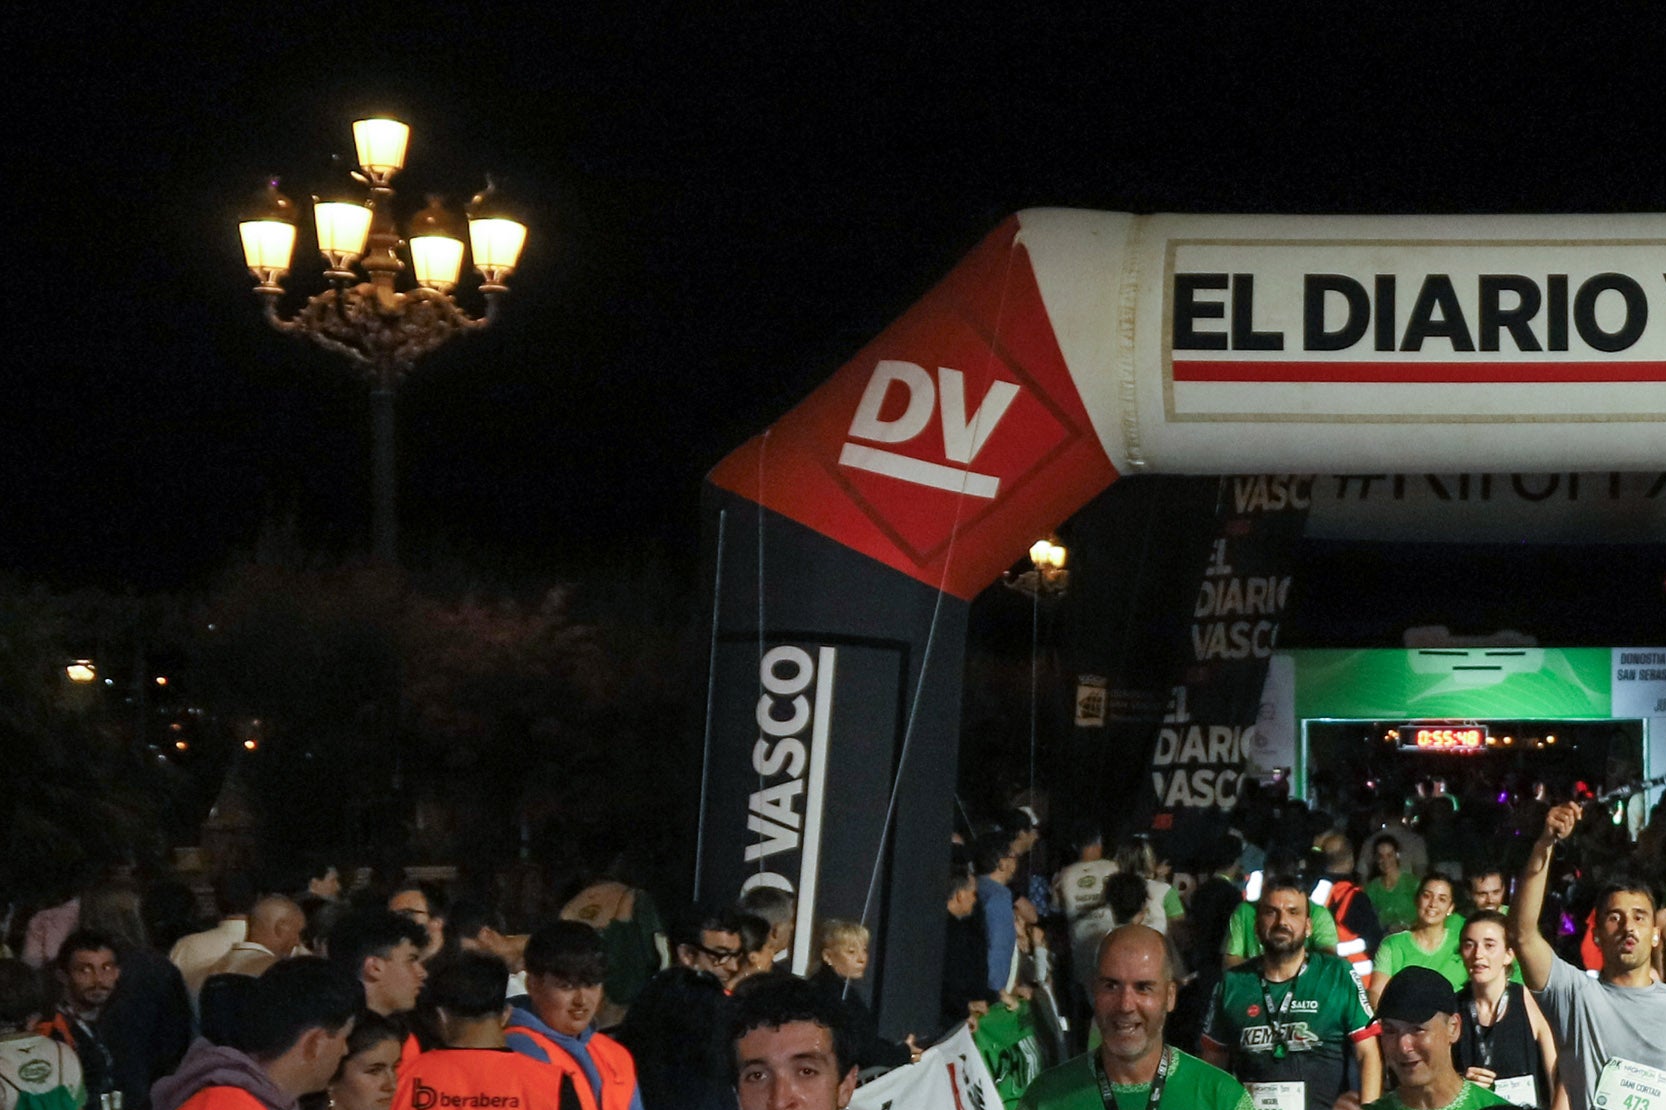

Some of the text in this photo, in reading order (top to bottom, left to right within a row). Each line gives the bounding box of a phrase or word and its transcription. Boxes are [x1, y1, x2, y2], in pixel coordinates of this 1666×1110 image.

[1174, 273, 1283, 351] EL
[1303, 272, 1648, 352] DIARIO
[847, 360, 1021, 464] DV
[1621, 653, 1666, 665] DONOSTIA
[1617, 669, 1636, 681] SAN
[1416, 729, 1479, 748] 0:55:48
[744, 646, 815, 863] VASCO
[1290, 1000, 1319, 1010] SALTO
[441, 1092, 519, 1107] berabera
